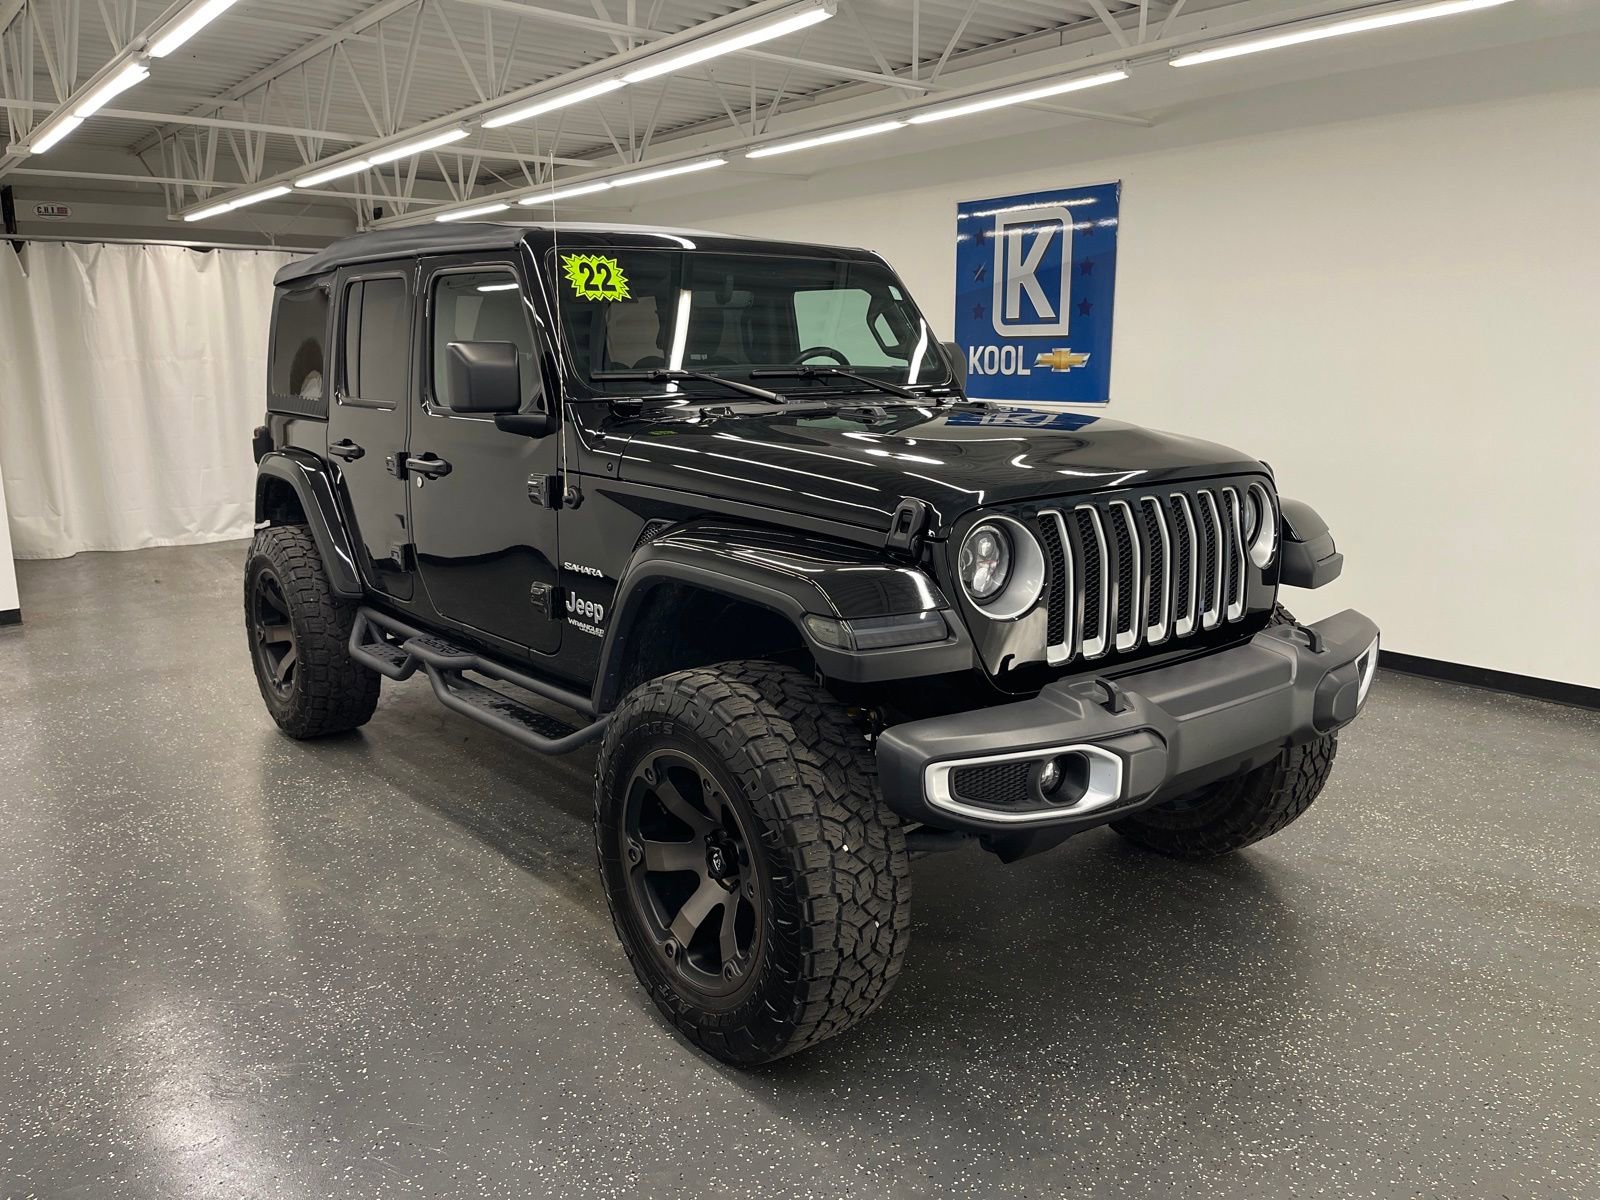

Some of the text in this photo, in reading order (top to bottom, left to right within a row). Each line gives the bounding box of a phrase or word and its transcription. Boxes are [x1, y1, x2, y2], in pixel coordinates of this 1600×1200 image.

[579, 262, 617, 292] 22
[1006, 227, 1057, 319] K
[969, 345, 1031, 376] KOOL
[564, 562, 603, 578] SAHARA
[565, 591, 604, 624] Jeep
